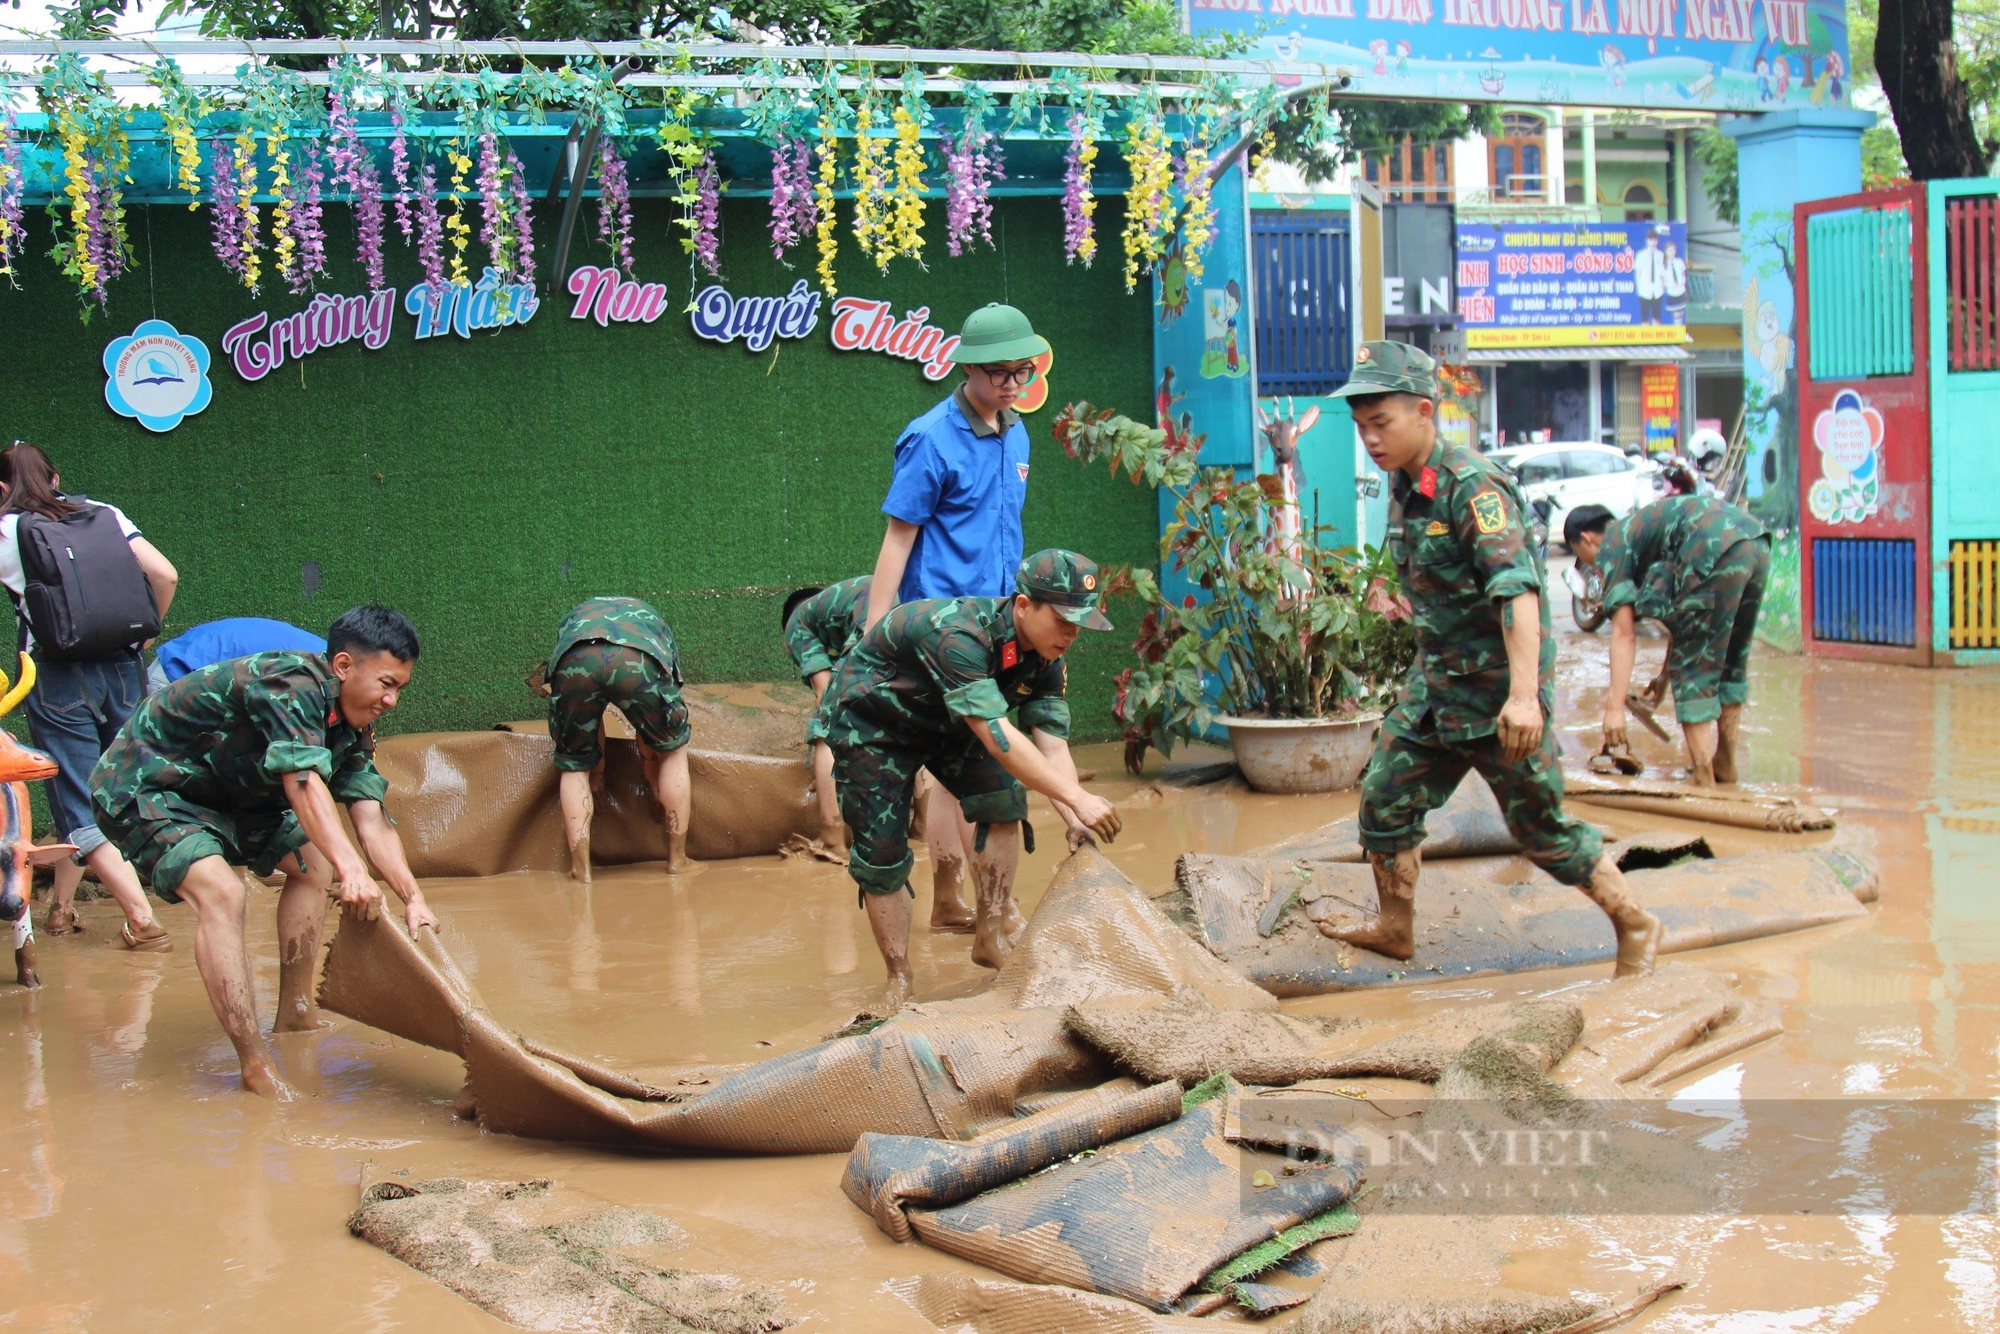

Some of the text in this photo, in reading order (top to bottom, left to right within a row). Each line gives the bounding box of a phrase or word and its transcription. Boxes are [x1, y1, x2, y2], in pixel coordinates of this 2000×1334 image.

[1761, 0, 1811, 46] VUI
[1504, 231, 1541, 247] CHUYÊN
[1541, 232, 1561, 247] MAY
[1604, 232, 1628, 249] PHỤC
[1458, 260, 1490, 288] INH
[1497, 245, 1635, 279] HỌC SINH CÔNG SỞ
[1615, 281, 1635, 294] THAO
[1458, 287, 1496, 323] HIẾN
[1594, 296, 1621, 310] PHÔNG
[222, 265, 961, 382] Trường Mầm Non Quyết Thắng
[147, 337, 163, 346] NON
